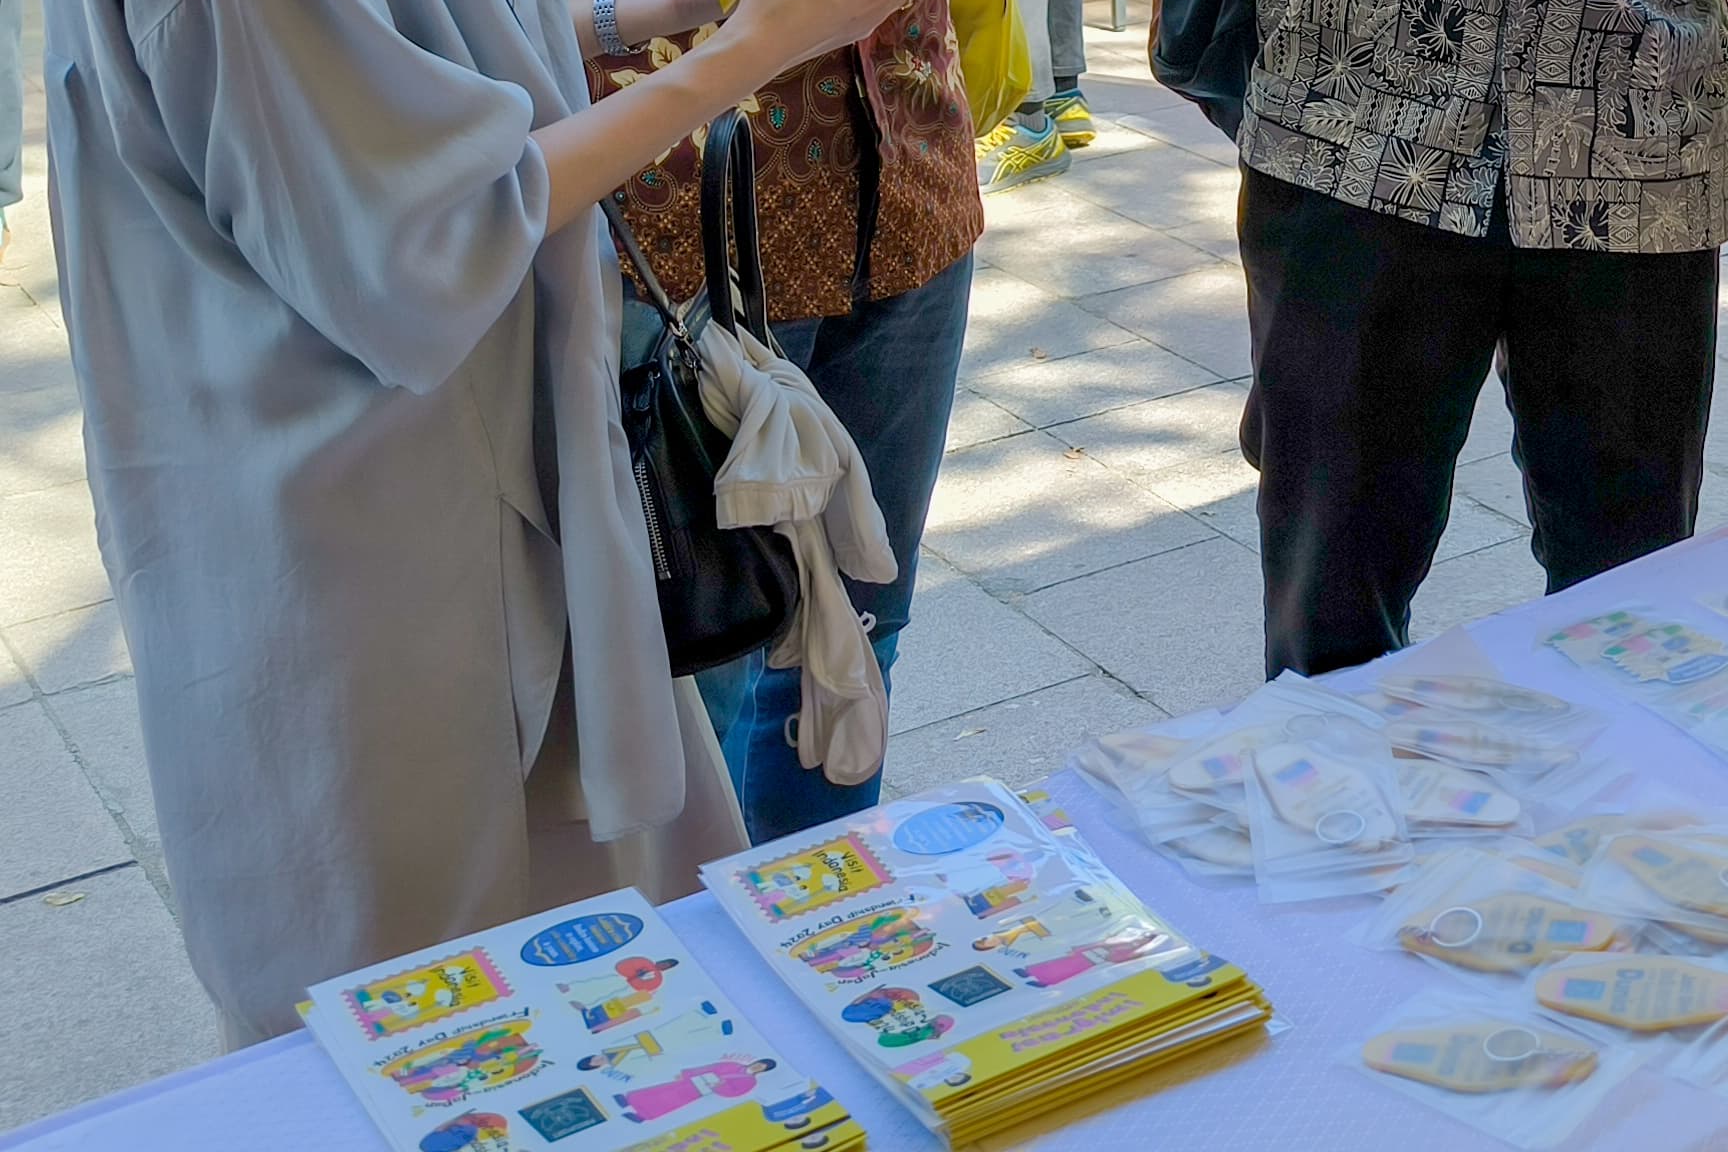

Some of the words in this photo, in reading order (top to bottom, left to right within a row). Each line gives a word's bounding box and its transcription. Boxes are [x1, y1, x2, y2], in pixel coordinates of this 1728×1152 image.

[811, 849, 850, 893] Indonesia
[841, 850, 865, 874] Visit
[816, 914, 844, 930] Day
[417, 1030, 449, 1048] Day
